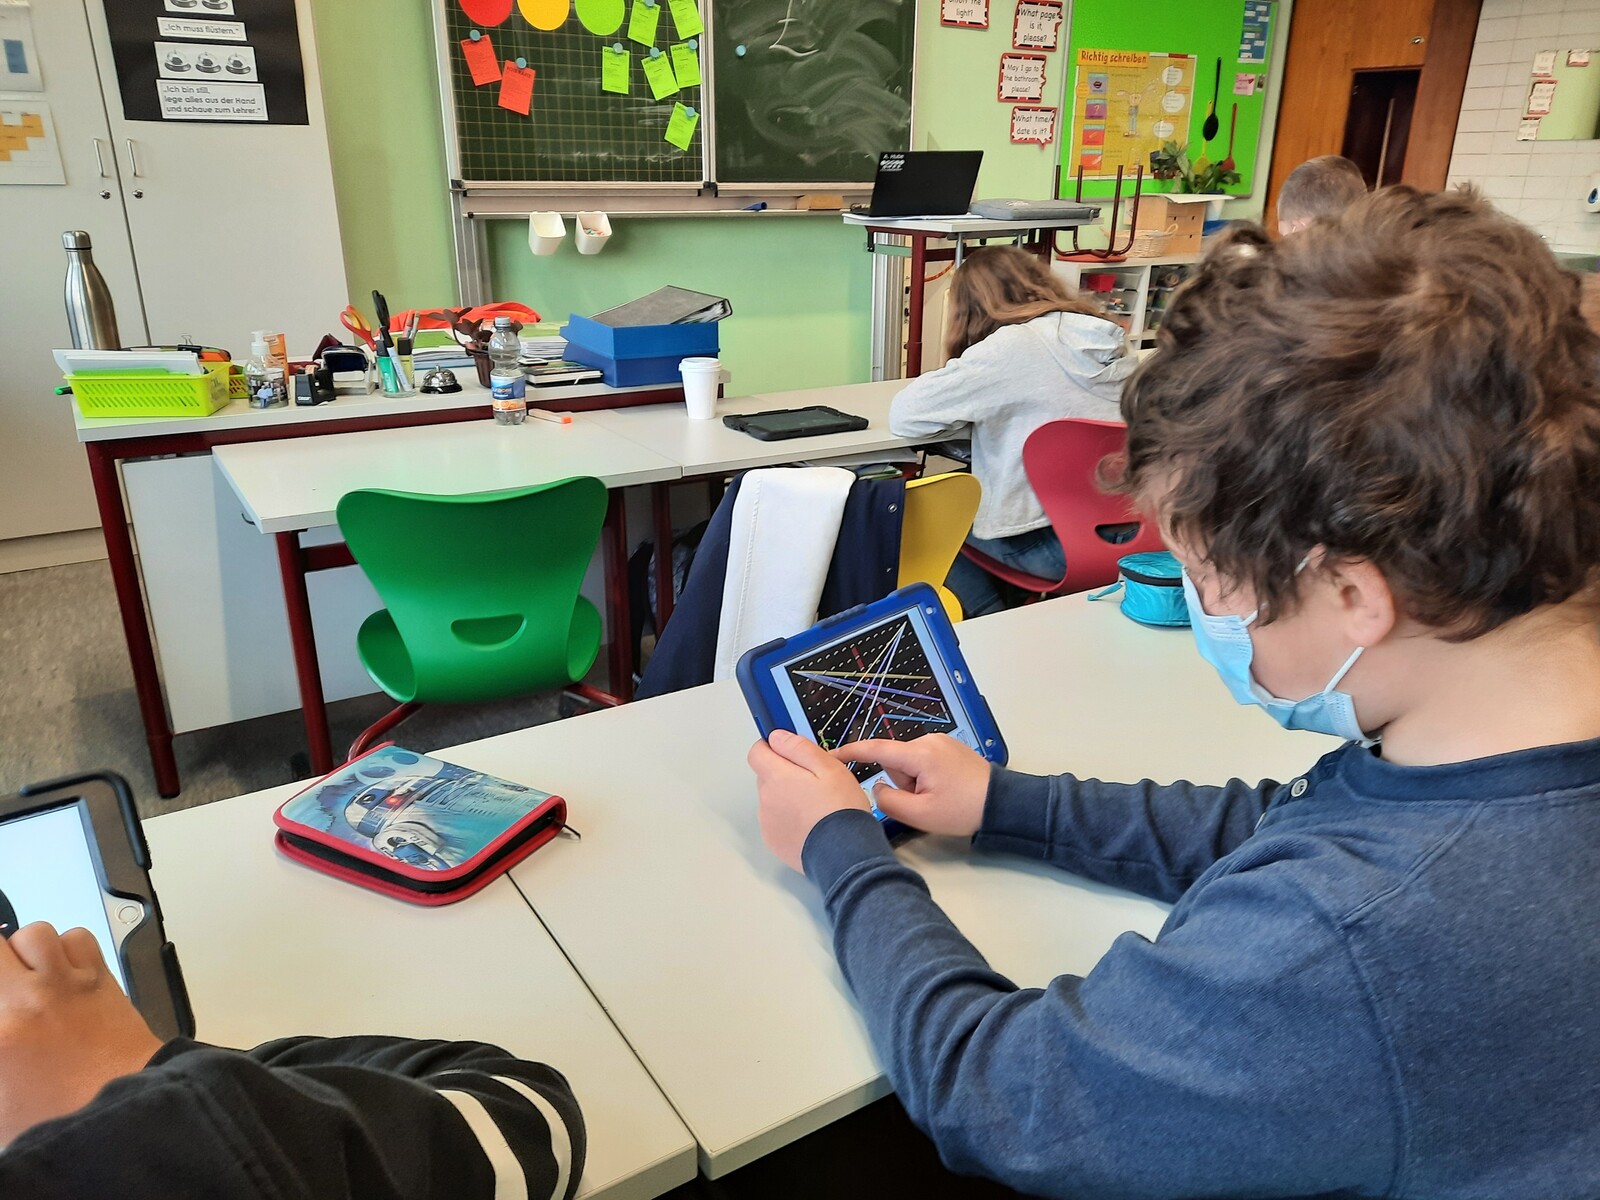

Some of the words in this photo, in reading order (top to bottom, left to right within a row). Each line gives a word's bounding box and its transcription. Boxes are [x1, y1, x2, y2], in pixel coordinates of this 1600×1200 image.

[956, 8, 974, 18] light?
[1020, 8, 1038, 17] What
[1040, 11, 1056, 21] page
[1023, 33, 1047, 42] please?
[1081, 50, 1108, 64] Richtig
[1109, 52, 1147, 64] schreiben
[1007, 64, 1018, 72] May
[164, 96, 182, 104] lege
